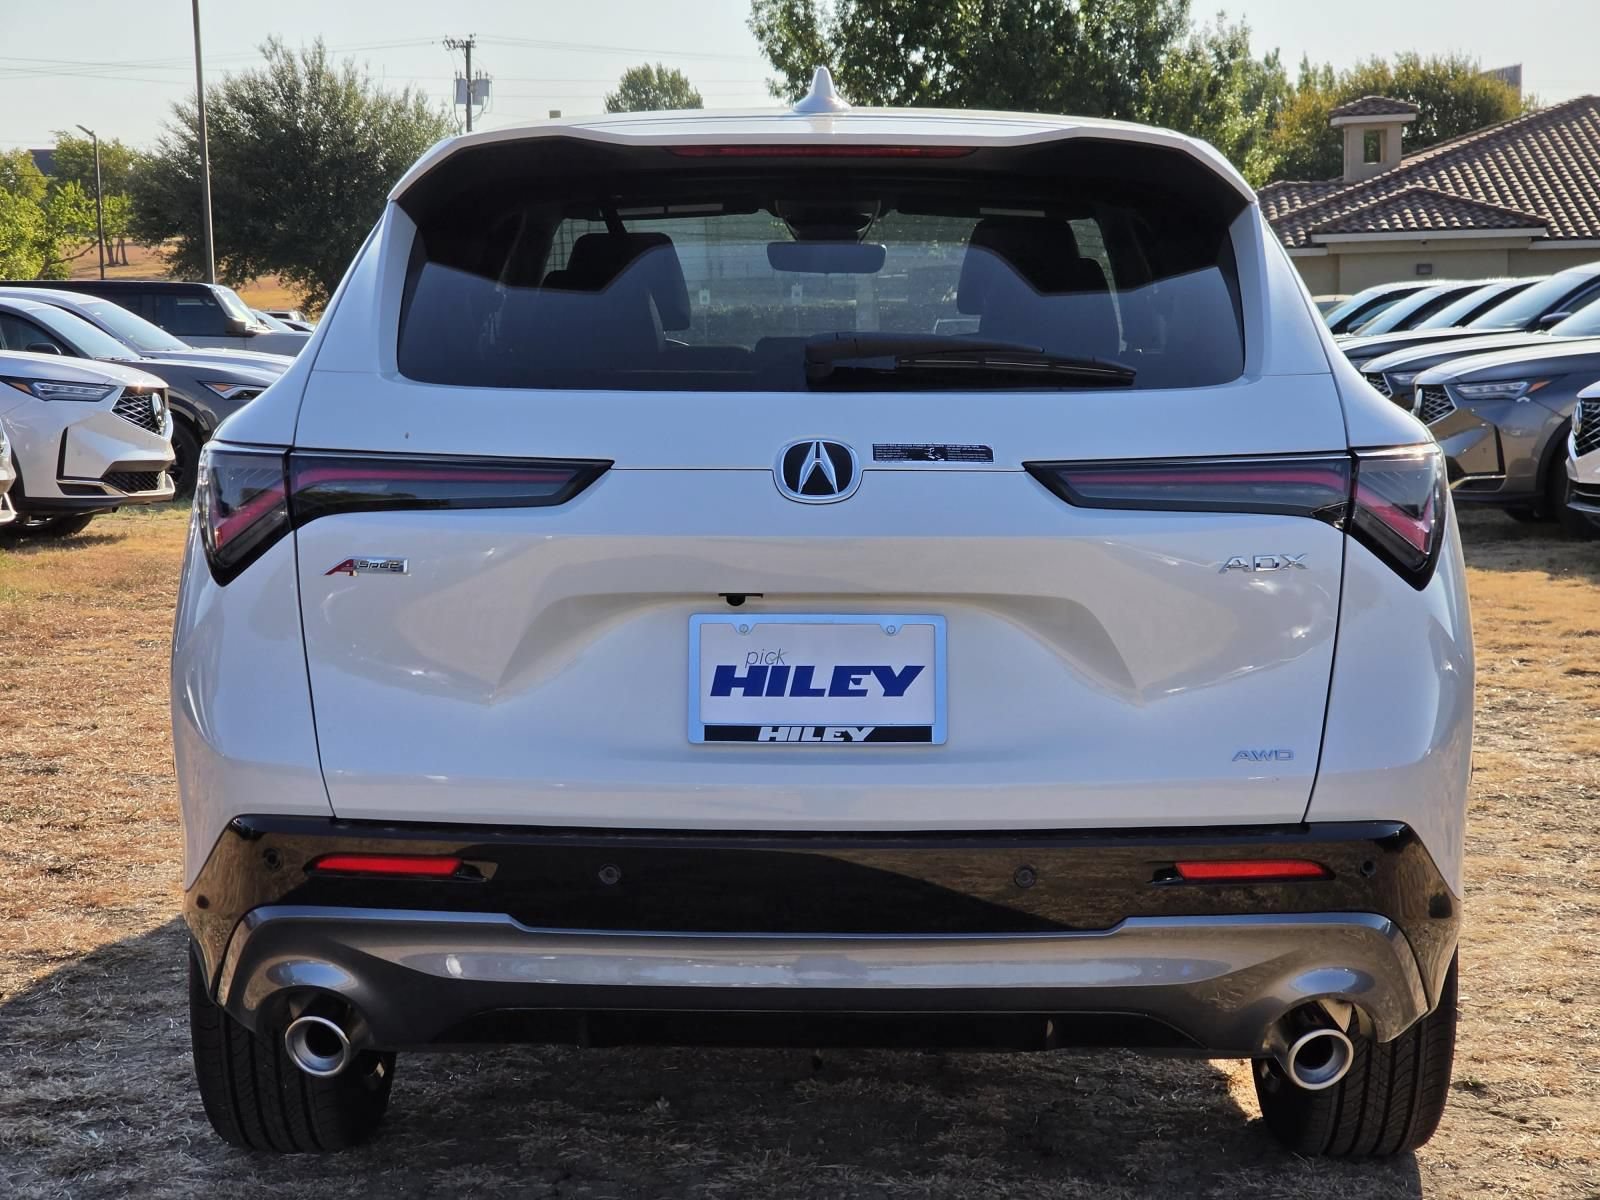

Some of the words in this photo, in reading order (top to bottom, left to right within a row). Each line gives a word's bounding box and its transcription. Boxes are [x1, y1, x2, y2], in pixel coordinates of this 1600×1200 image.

[1218, 553, 1309, 574] ADX
[745, 648, 788, 667] pick
[710, 665, 925, 697] HILEY
[757, 726, 876, 742] HILEY
[1231, 749, 1295, 762] AWD
